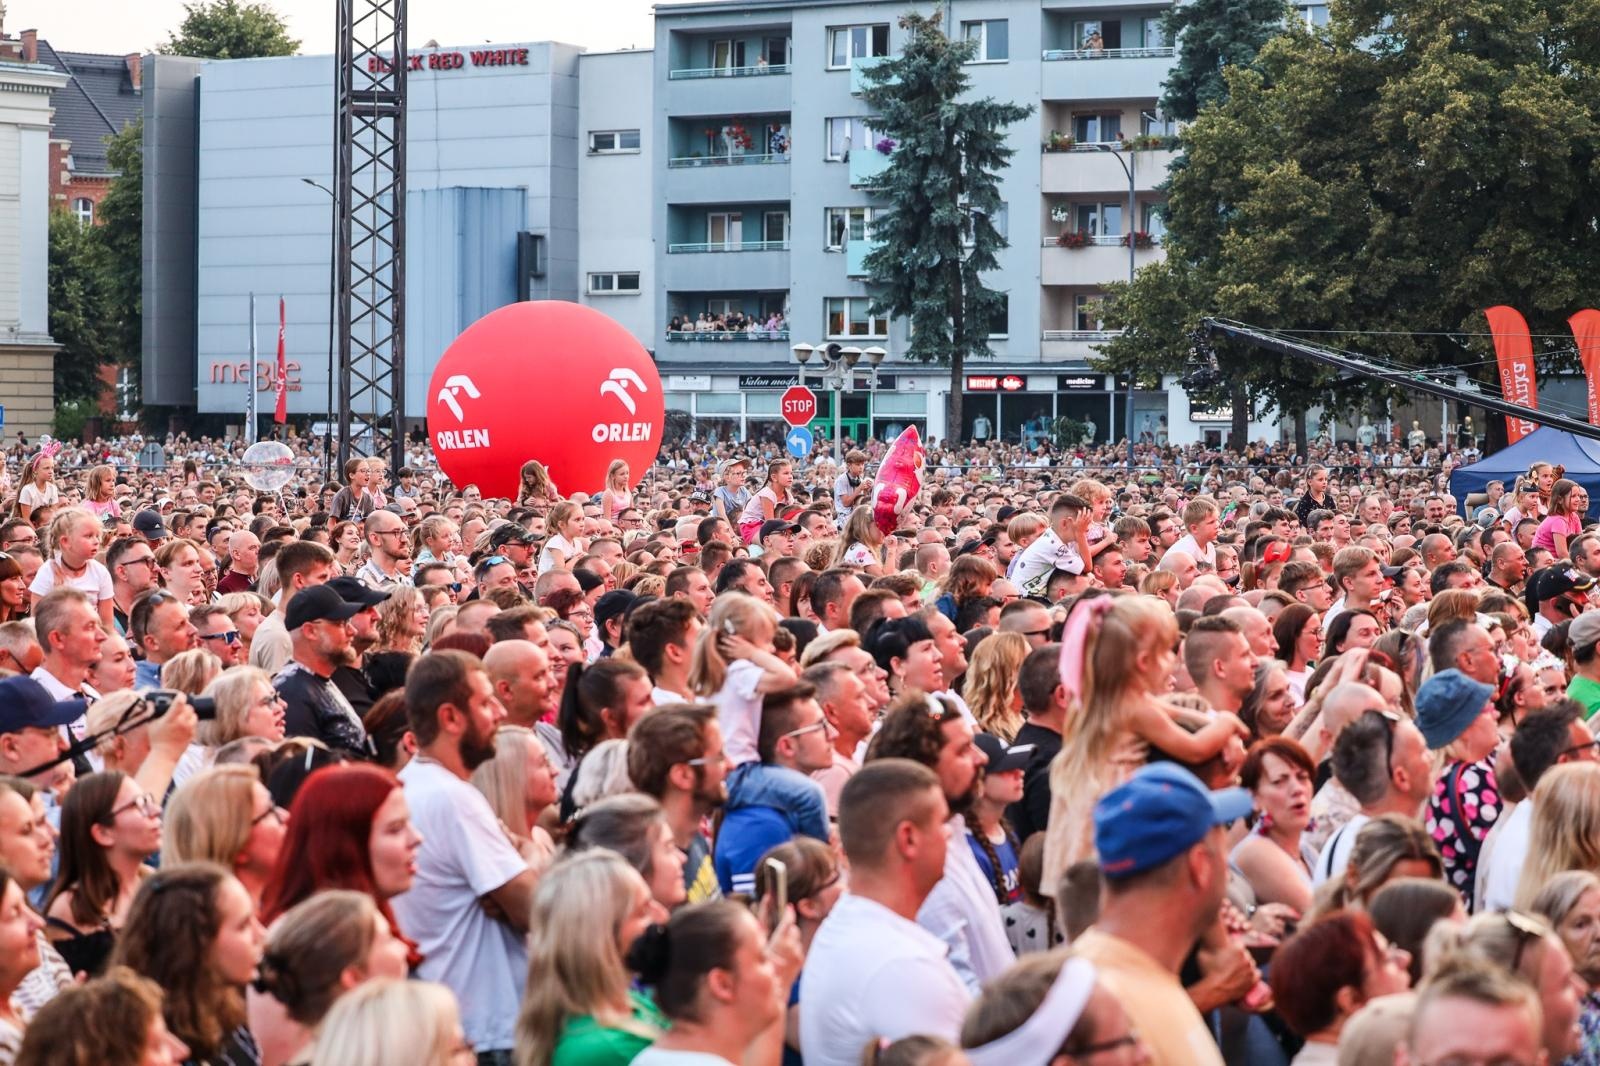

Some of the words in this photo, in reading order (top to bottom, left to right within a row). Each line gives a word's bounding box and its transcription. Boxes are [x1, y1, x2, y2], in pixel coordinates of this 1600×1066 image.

[368, 54, 424, 73] BLK
[428, 51, 464, 70] RED
[470, 48, 529, 66] WHITE
[741, 376, 769, 386] Salon
[770, 376, 798, 388] mody
[784, 400, 813, 413] STOP
[437, 428, 490, 450] ORLEN
[592, 422, 652, 443] ORLEN
